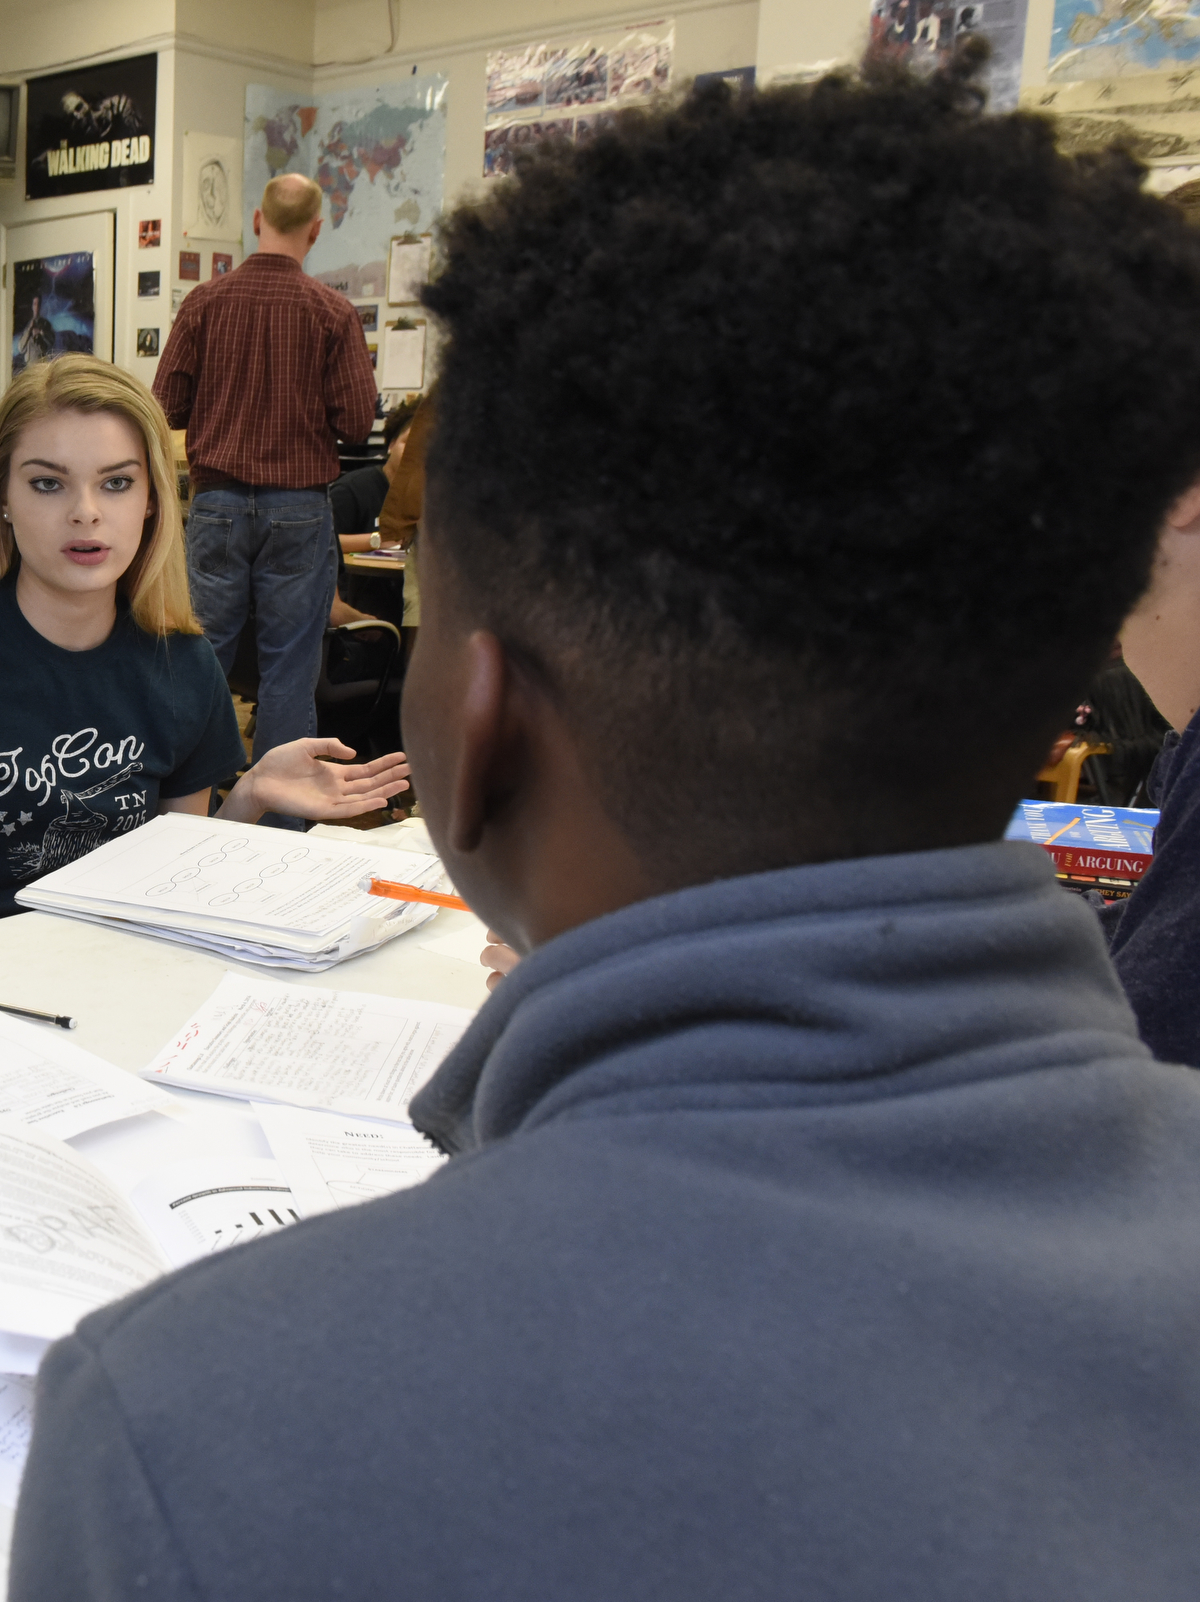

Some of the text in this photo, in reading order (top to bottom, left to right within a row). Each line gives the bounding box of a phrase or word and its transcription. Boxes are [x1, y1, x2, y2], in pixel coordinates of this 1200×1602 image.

[47, 134, 150, 177] WALKING DEAD
[114, 789, 147, 811] TN
[112, 810, 147, 832] 2015
[1075, 855, 1144, 874] ARGUING
[344, 1131, 384, 1139] NEED:
